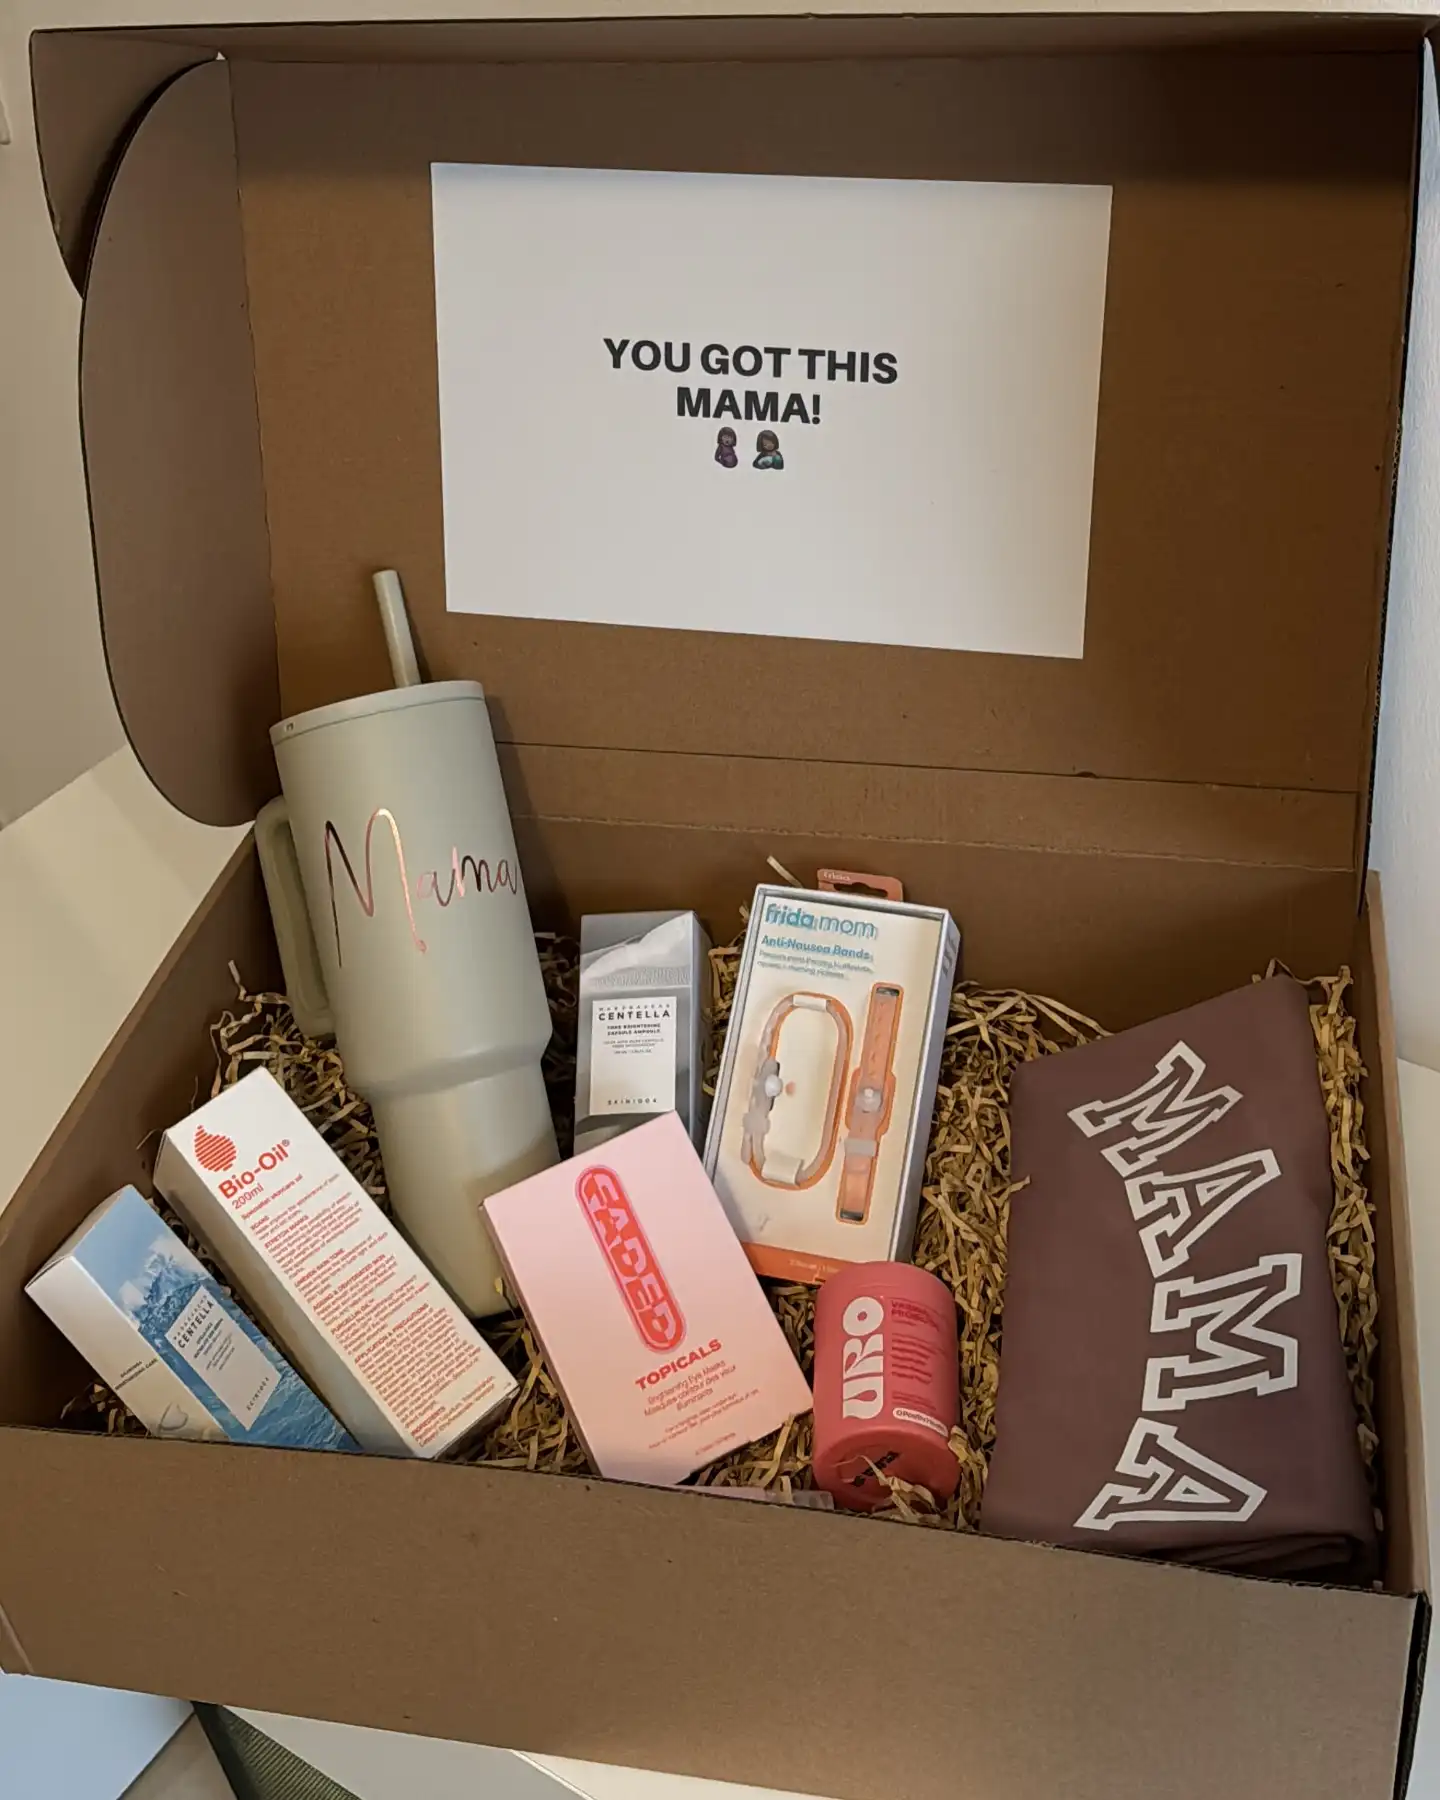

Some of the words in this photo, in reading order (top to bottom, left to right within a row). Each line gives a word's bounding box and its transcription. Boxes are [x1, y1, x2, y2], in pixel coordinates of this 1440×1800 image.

[603, 337, 691, 373] YOU
[700, 343, 792, 379] GOT
[798, 348, 899, 385] THIS
[676, 386, 821, 425] MAMA!
[324, 807, 518, 968] Mama
[764, 903, 815, 928] frida
[819, 914, 877, 938] mom
[598, 1010, 671, 1021] CENTELLA
[231, 1182, 265, 1210] 200ml
[583, 1173, 678, 1341] FADED
[1067, 1040, 1302, 1531] MAMA
[176, 1300, 216, 1349] CENTELLA
[634, 1338, 723, 1391] TOPICALS
[842, 1295, 885, 1420] URO
